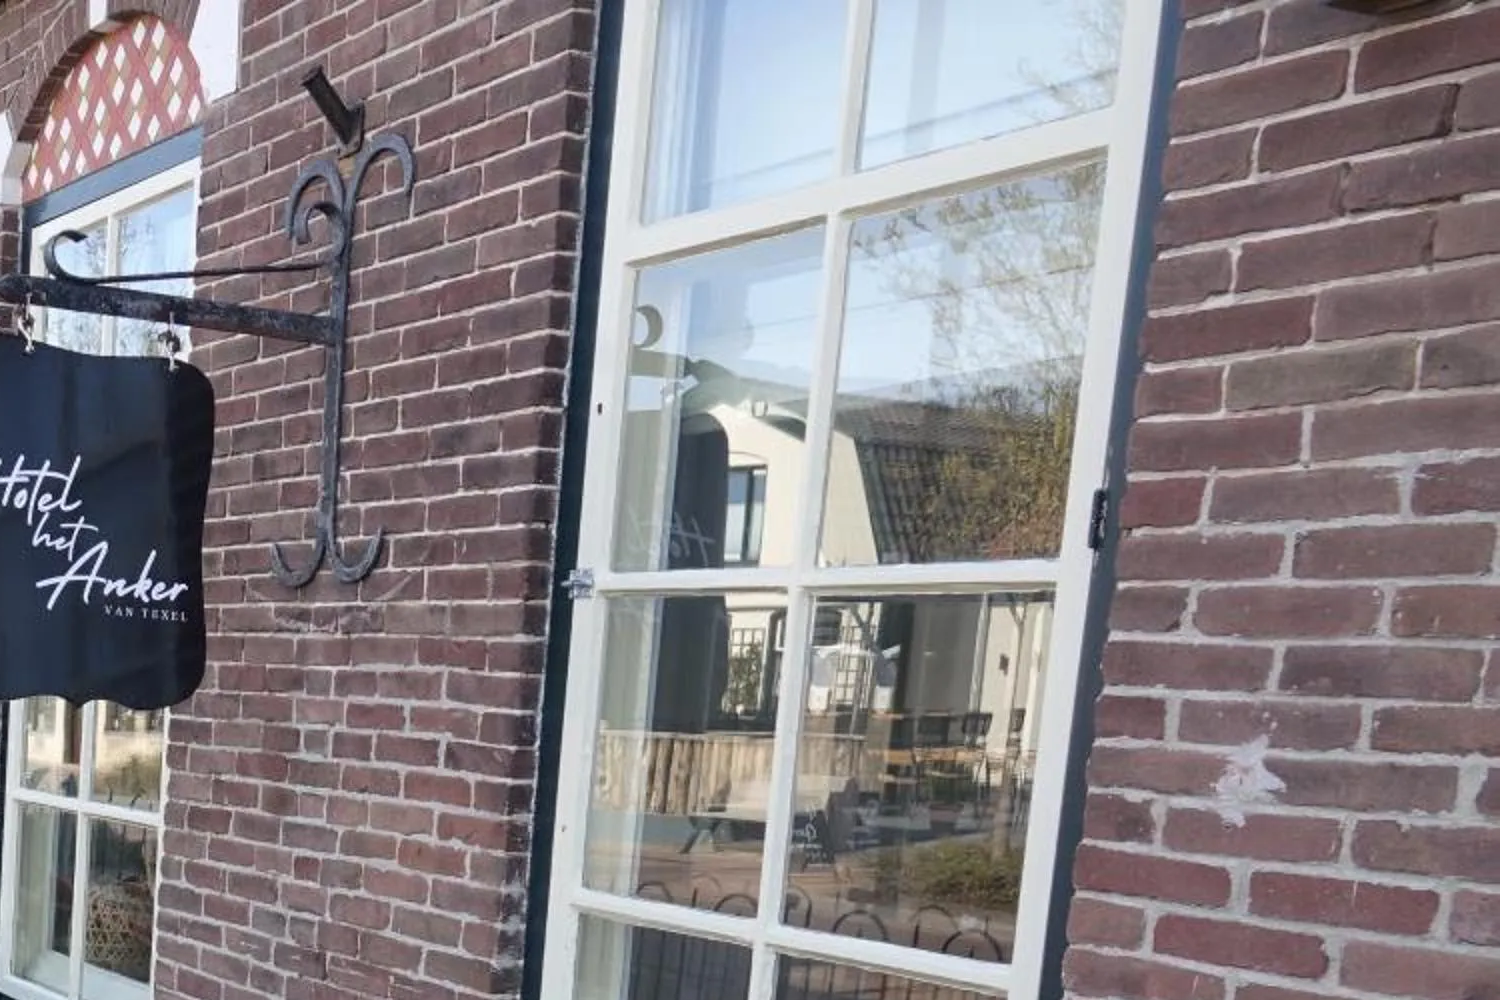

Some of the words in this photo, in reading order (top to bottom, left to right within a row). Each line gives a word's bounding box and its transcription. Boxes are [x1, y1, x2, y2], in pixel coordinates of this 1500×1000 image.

[31, 513, 99, 562] het
[35, 541, 189, 611] Anker
[103, 603, 134, 618] VAN
[142, 607, 188, 622] TEXEL
